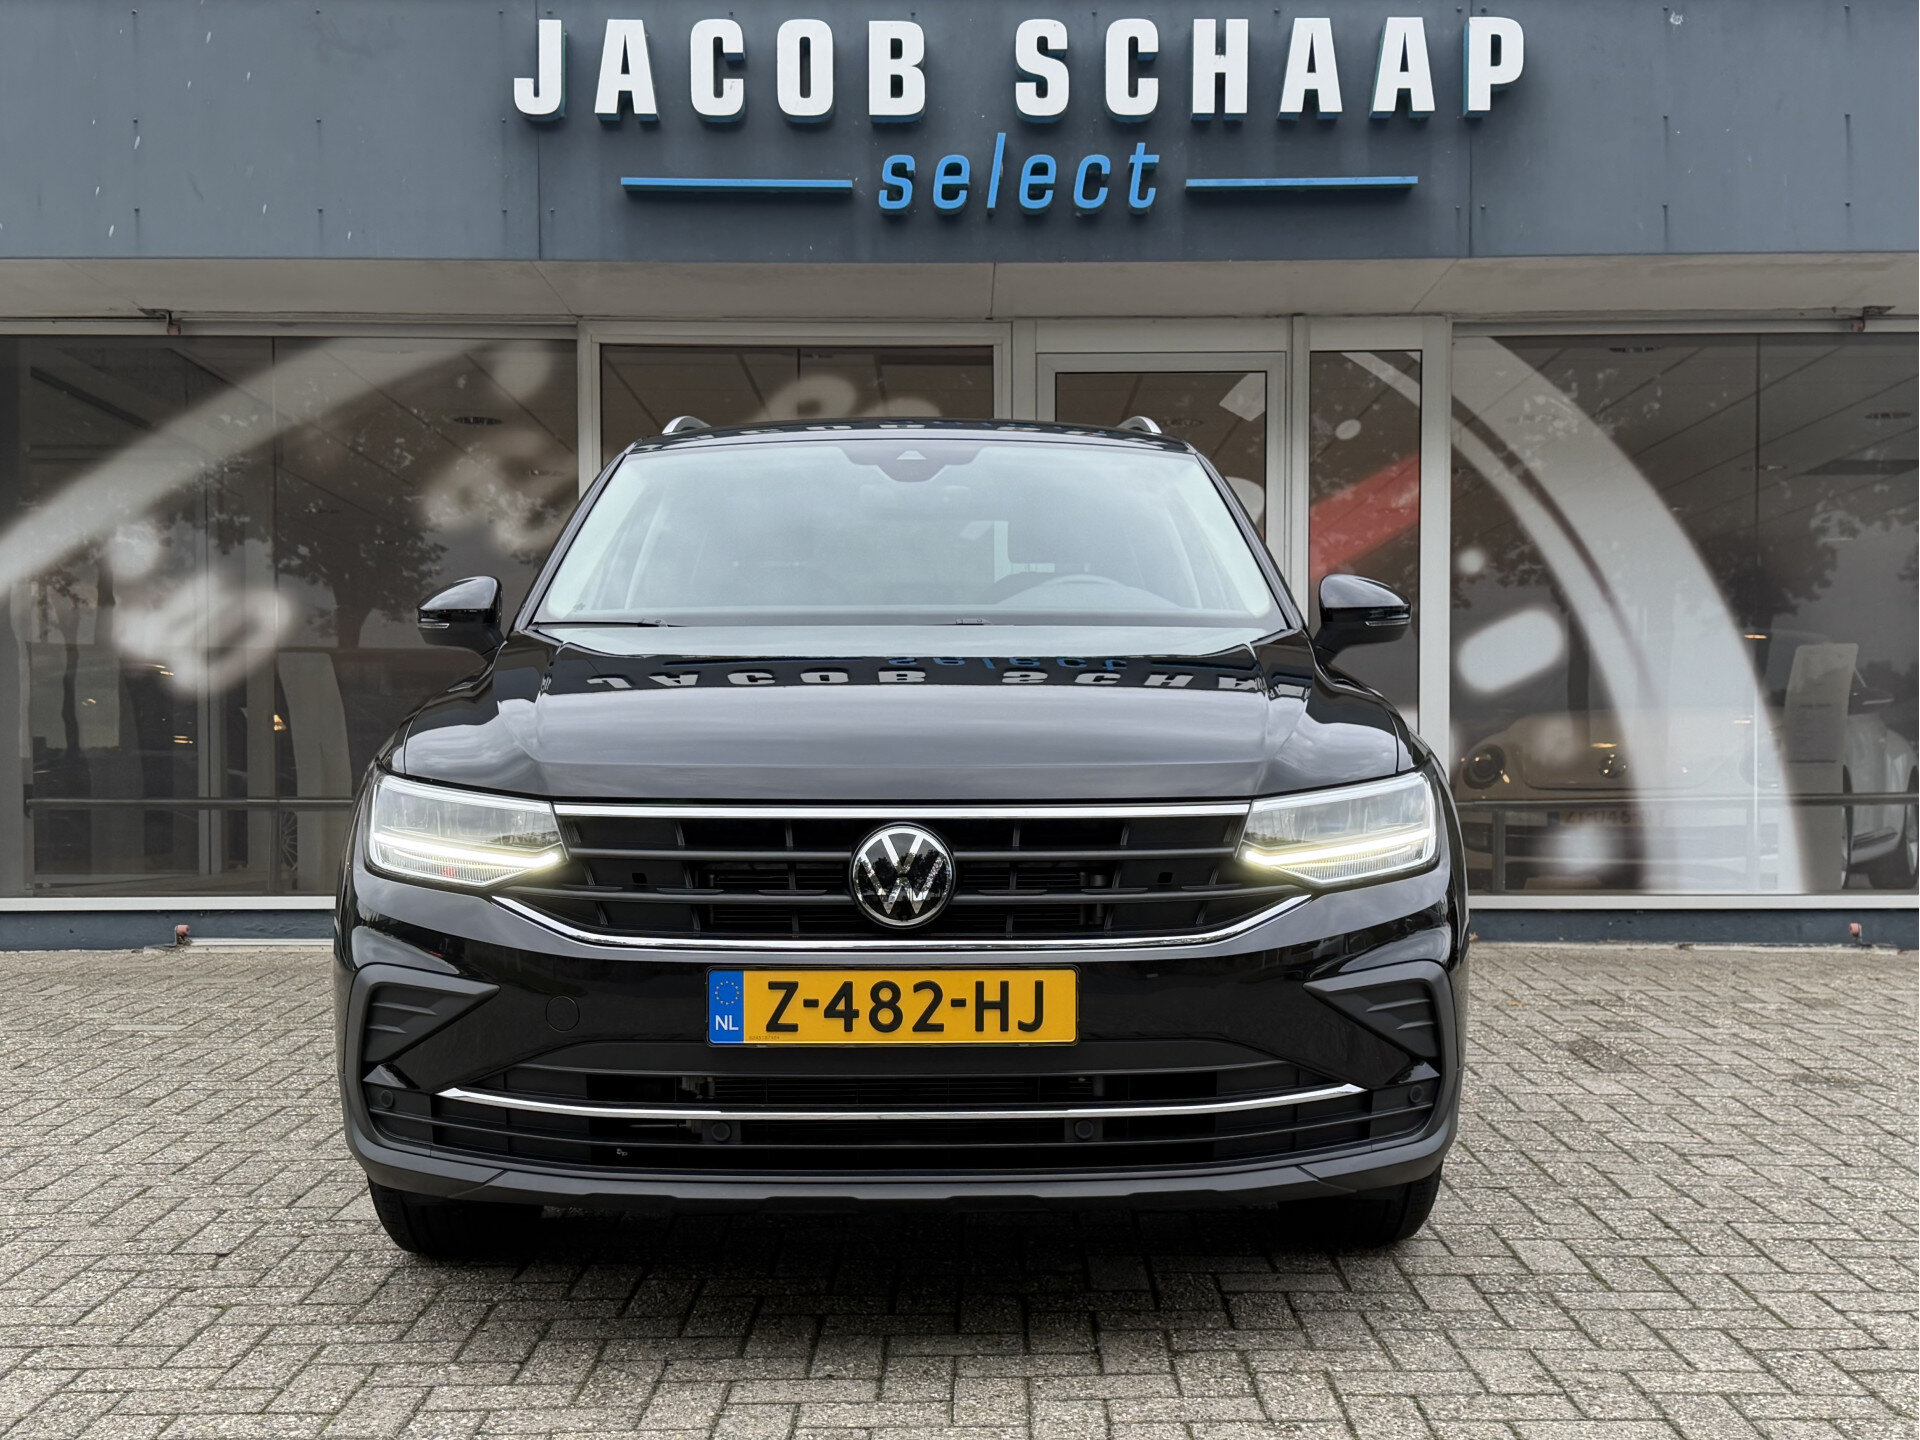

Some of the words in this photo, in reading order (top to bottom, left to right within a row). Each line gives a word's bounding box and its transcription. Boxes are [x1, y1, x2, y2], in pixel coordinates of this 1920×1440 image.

[514, 18, 926, 118] JACOB
[1015, 17, 1525, 118] SCHAAP
[878, 132, 1160, 212] select
[854, 828, 951, 925] VW
[714, 1014, 739, 1031] NL
[765, 980, 1044, 1033] Z-482-HJ
